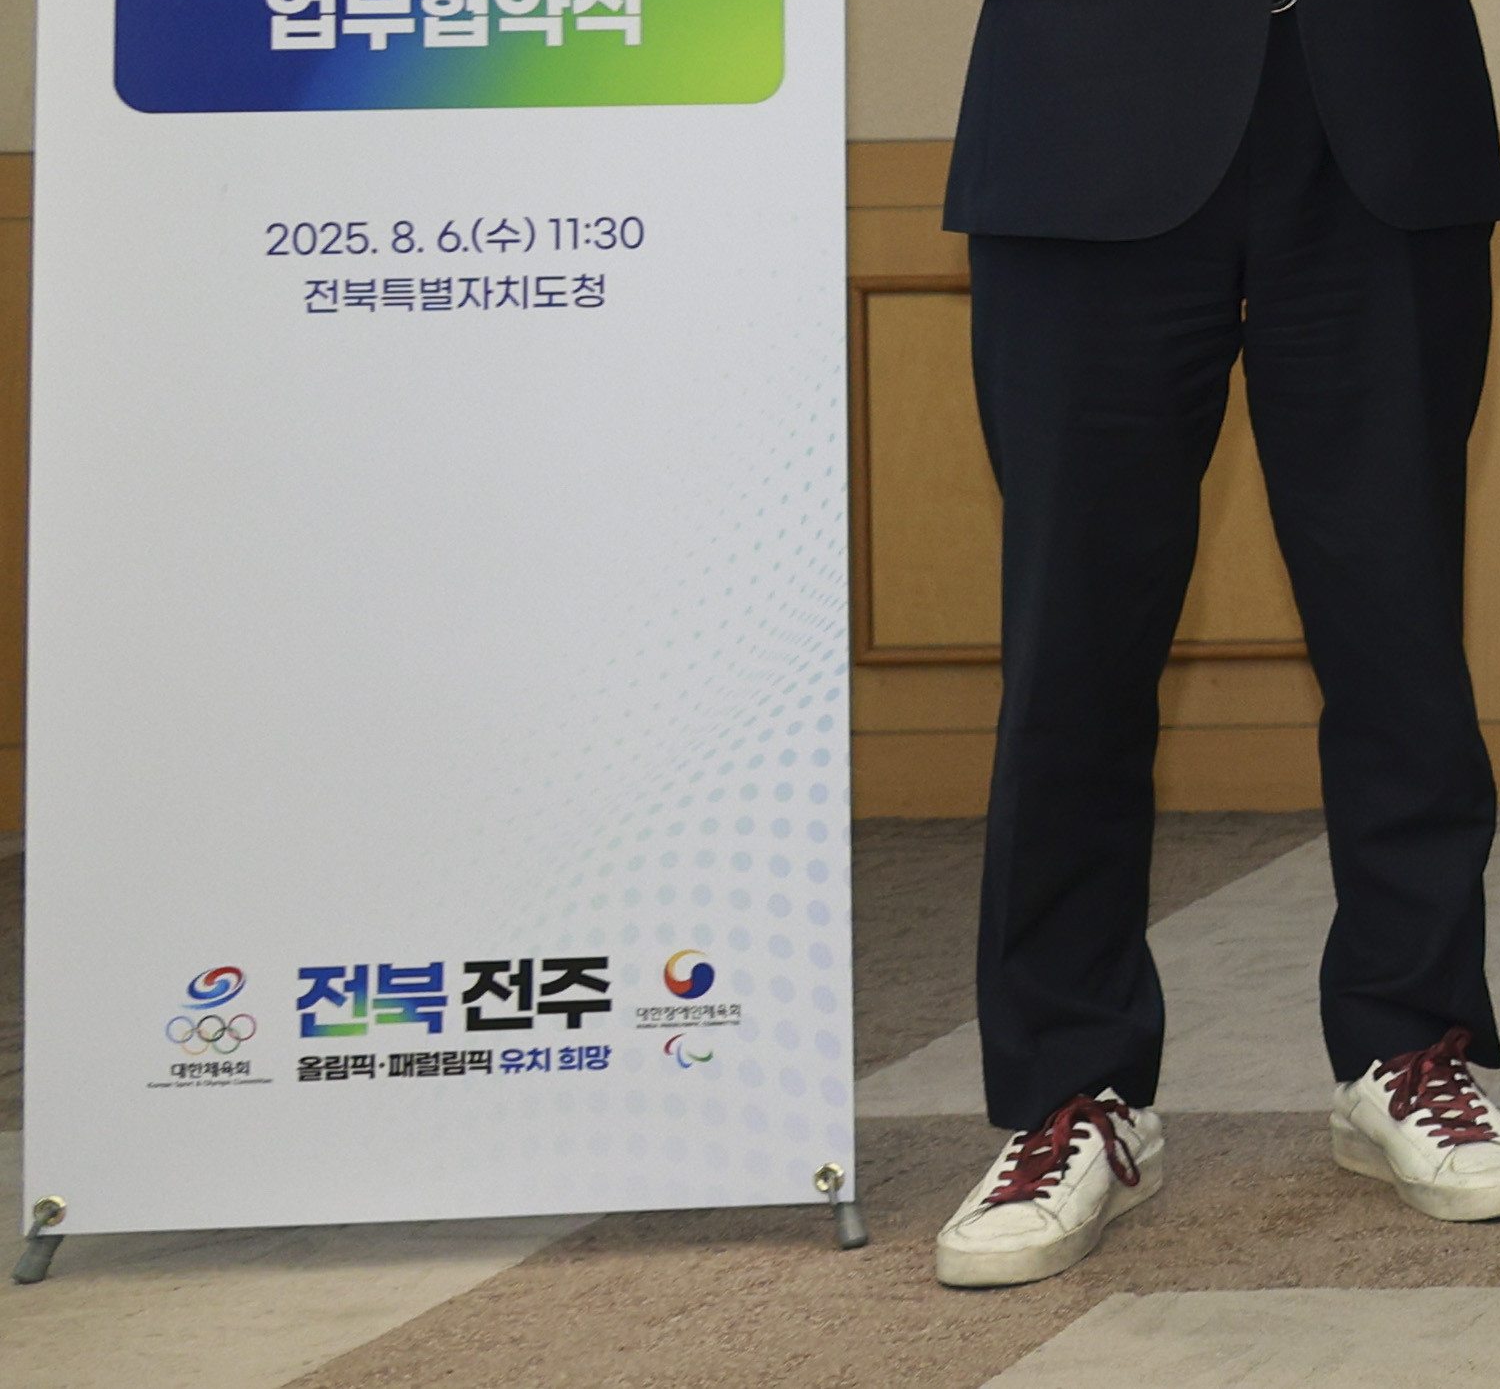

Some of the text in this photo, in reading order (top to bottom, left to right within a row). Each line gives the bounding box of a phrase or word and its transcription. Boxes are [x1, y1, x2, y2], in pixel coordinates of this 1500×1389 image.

[266, 215, 645, 256] 2025. 8. 6.(수) 11:30
[304, 273, 605, 314] 전북특별자치도청
[296, 956, 612, 1039] 전북 전주
[170, 1060, 252, 1079] 대한체육회
[499, 1047, 551, 1075] 유치
[558, 1045, 612, 1071] 희망
